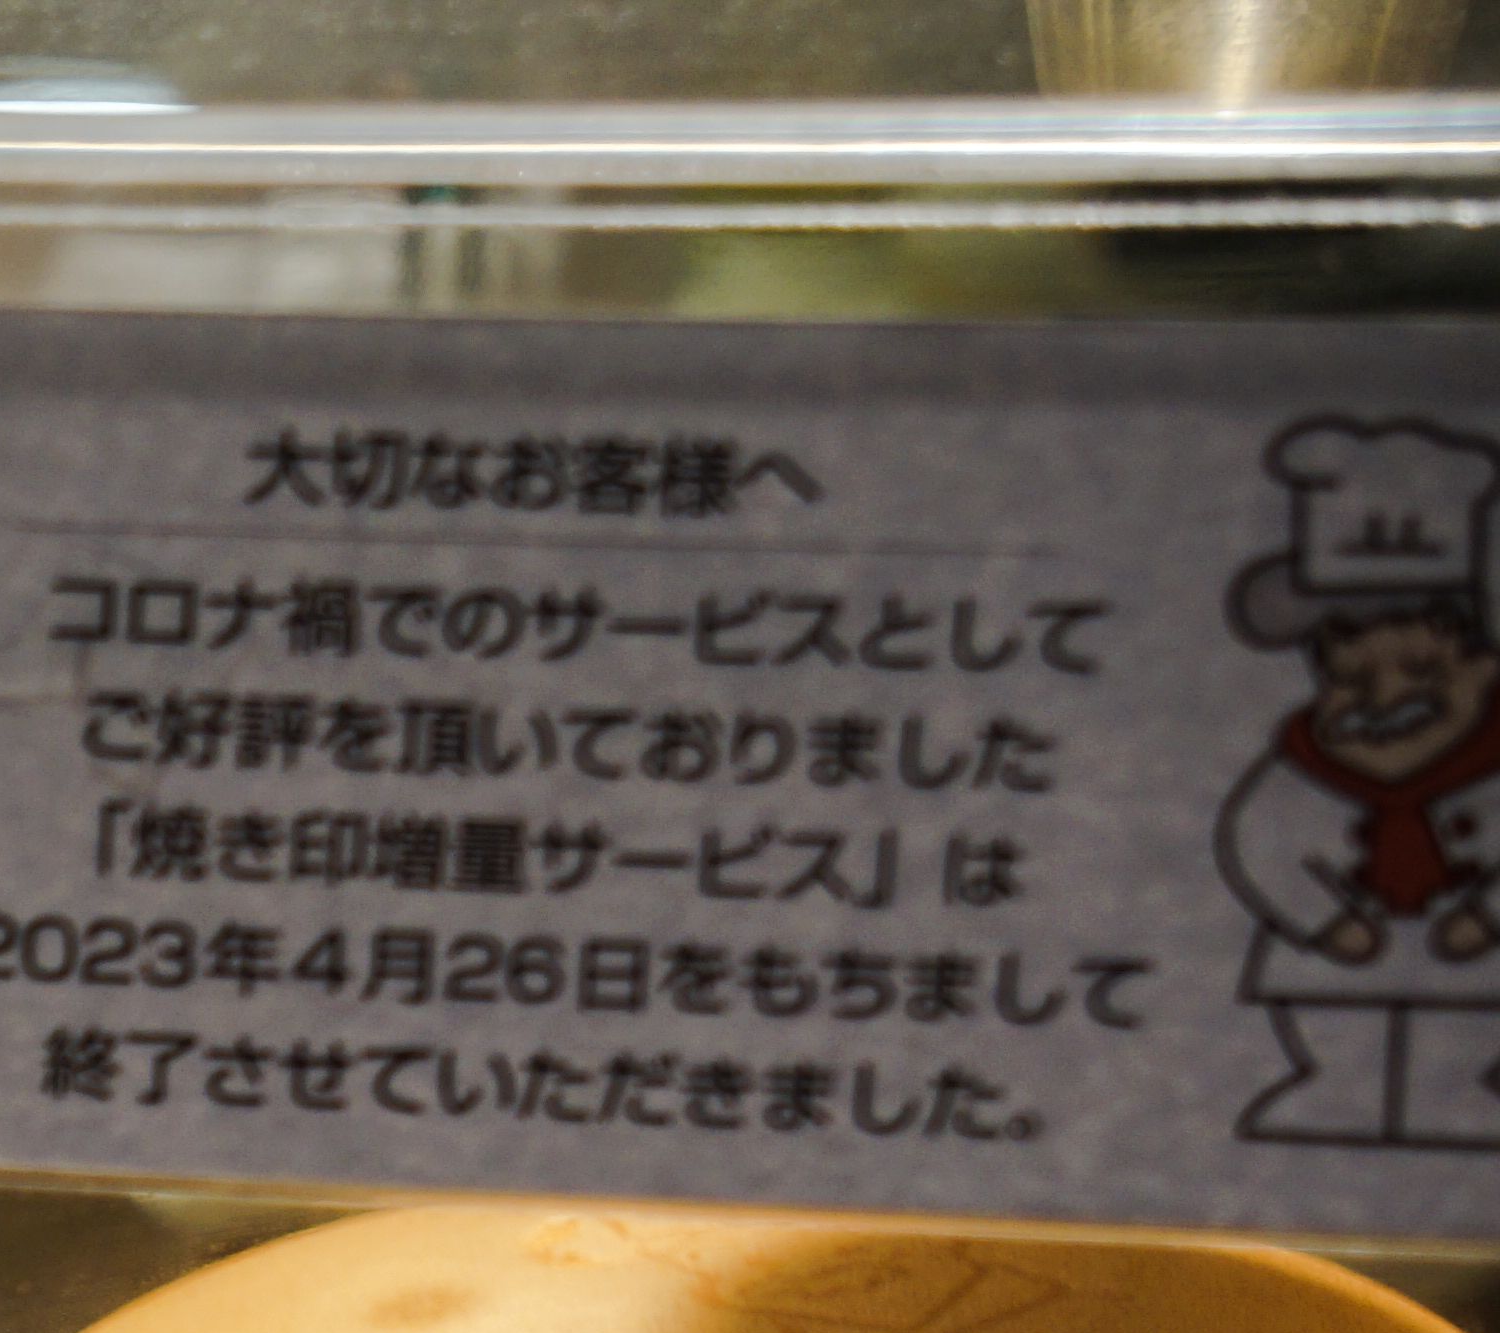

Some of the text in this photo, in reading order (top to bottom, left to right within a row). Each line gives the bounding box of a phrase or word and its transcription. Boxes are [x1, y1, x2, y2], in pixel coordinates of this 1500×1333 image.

[245, 428, 823, 521] 大切なお客様へ
[49, 575, 1111, 677] コロナ禍でのサービスとして
[81, 690, 1058, 794] ご好評を頂いておりました
[94, 805, 1027, 910] 「焼き印増量サービス」は
[40, 1031, 1047, 1145] 終了させていただきました。
